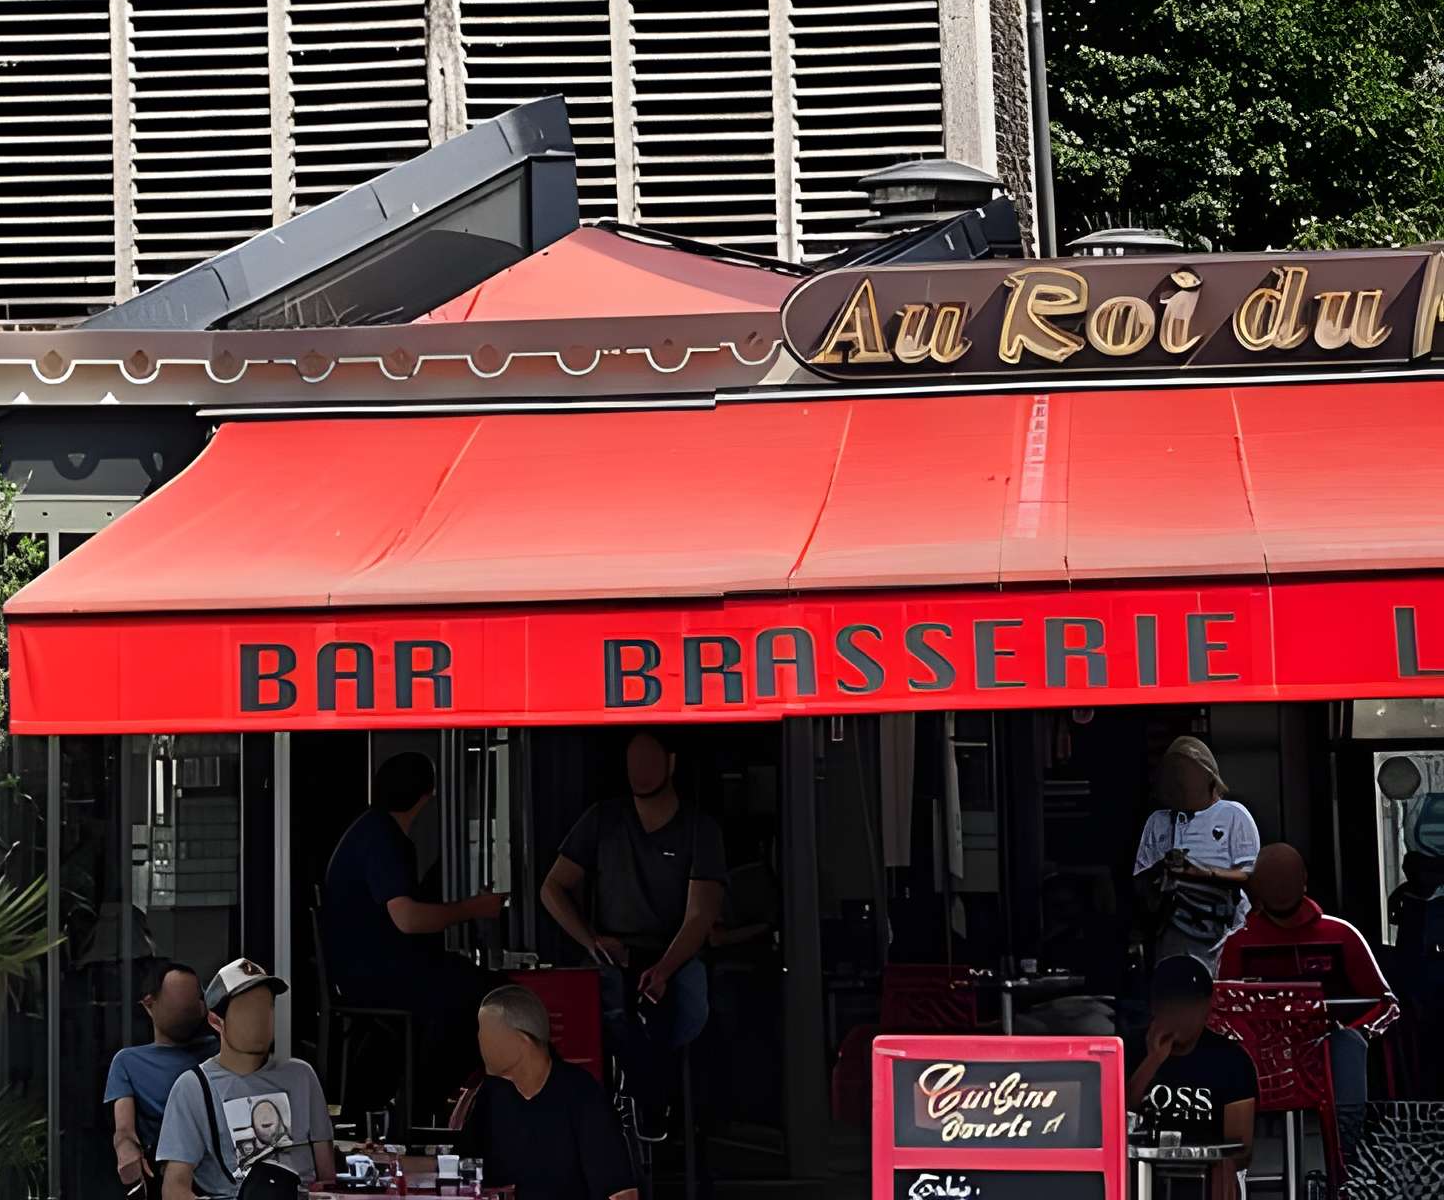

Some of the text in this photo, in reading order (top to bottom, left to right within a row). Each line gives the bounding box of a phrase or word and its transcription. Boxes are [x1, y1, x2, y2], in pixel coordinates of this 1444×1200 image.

[806, 277, 973, 364] Au
[999, 266, 1204, 365] Roi
[1232, 266, 1393, 351] du
[239, 639, 454, 713] BAR
[603, 611, 1242, 709] BRASSERIE
[1144, 1084, 1213, 1112] OSS
